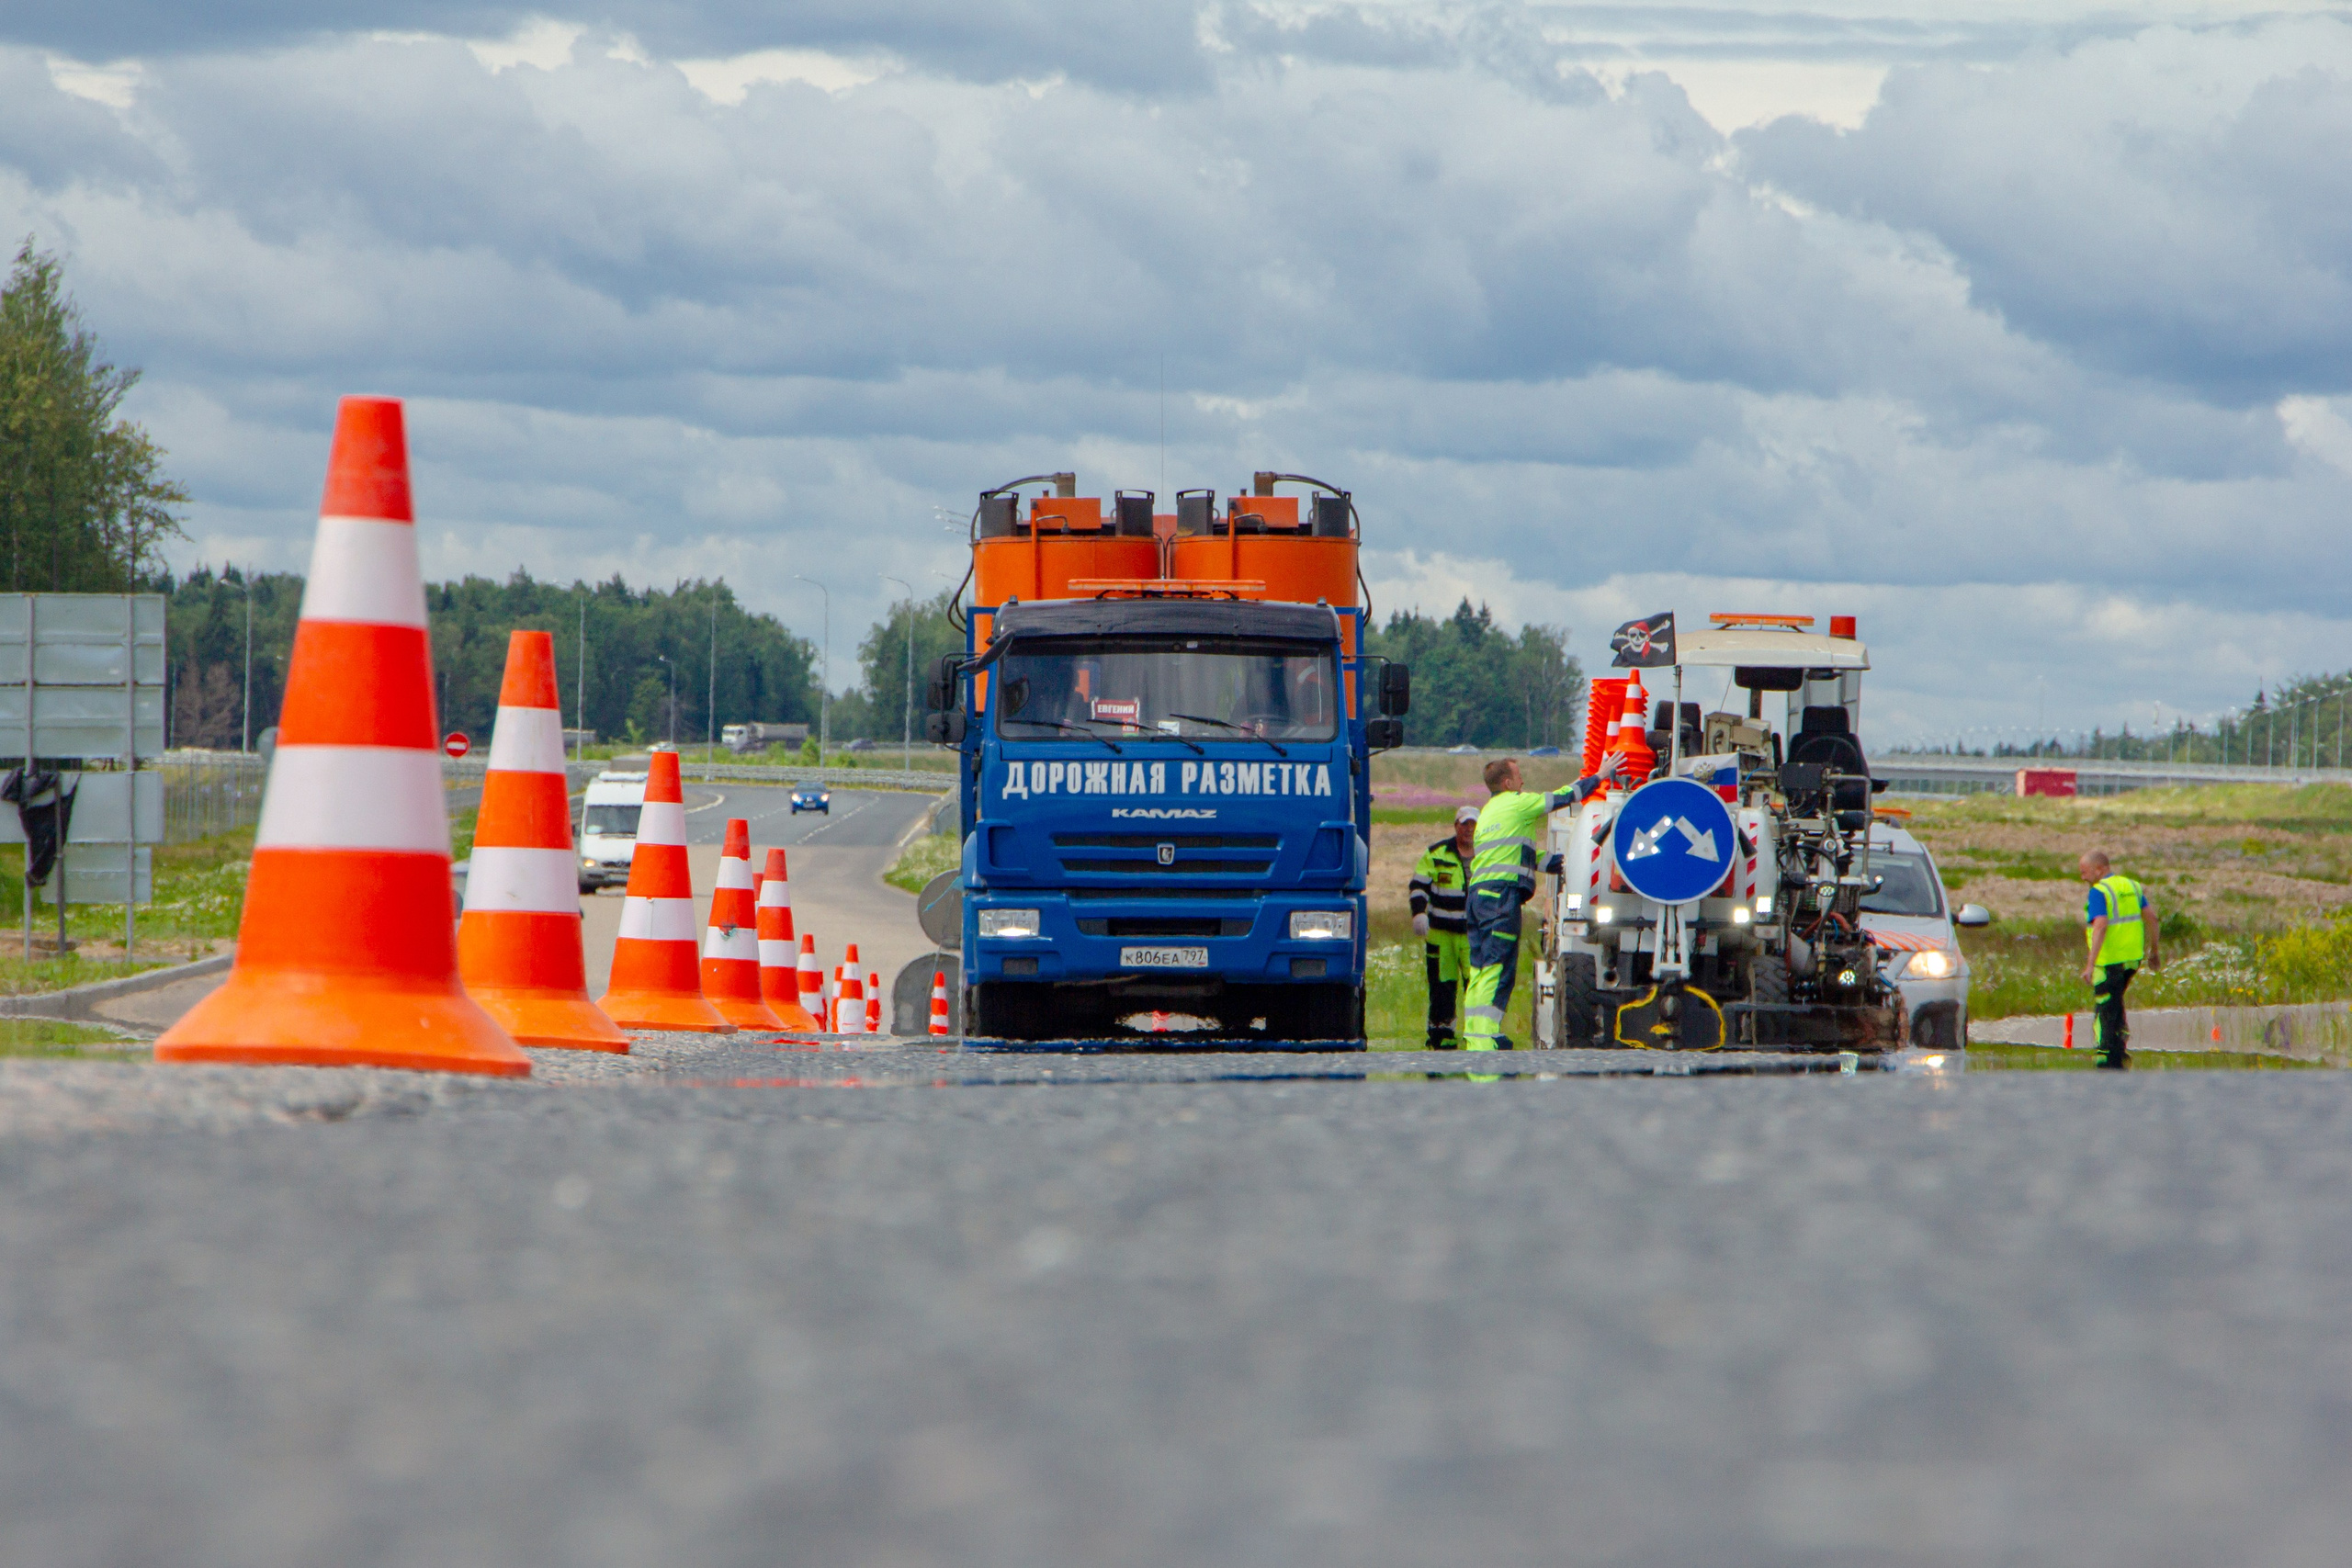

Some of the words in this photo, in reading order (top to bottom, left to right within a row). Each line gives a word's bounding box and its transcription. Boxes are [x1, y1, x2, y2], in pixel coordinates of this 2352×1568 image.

[1097, 704, 1135, 714] ЕВГЕНИЙ
[1002, 762, 1166, 799] ДОРОЖНАЯ
[1182, 762, 1331, 796] РАЗМЕТКА
[1112, 808, 1217, 818] KAMAZ
